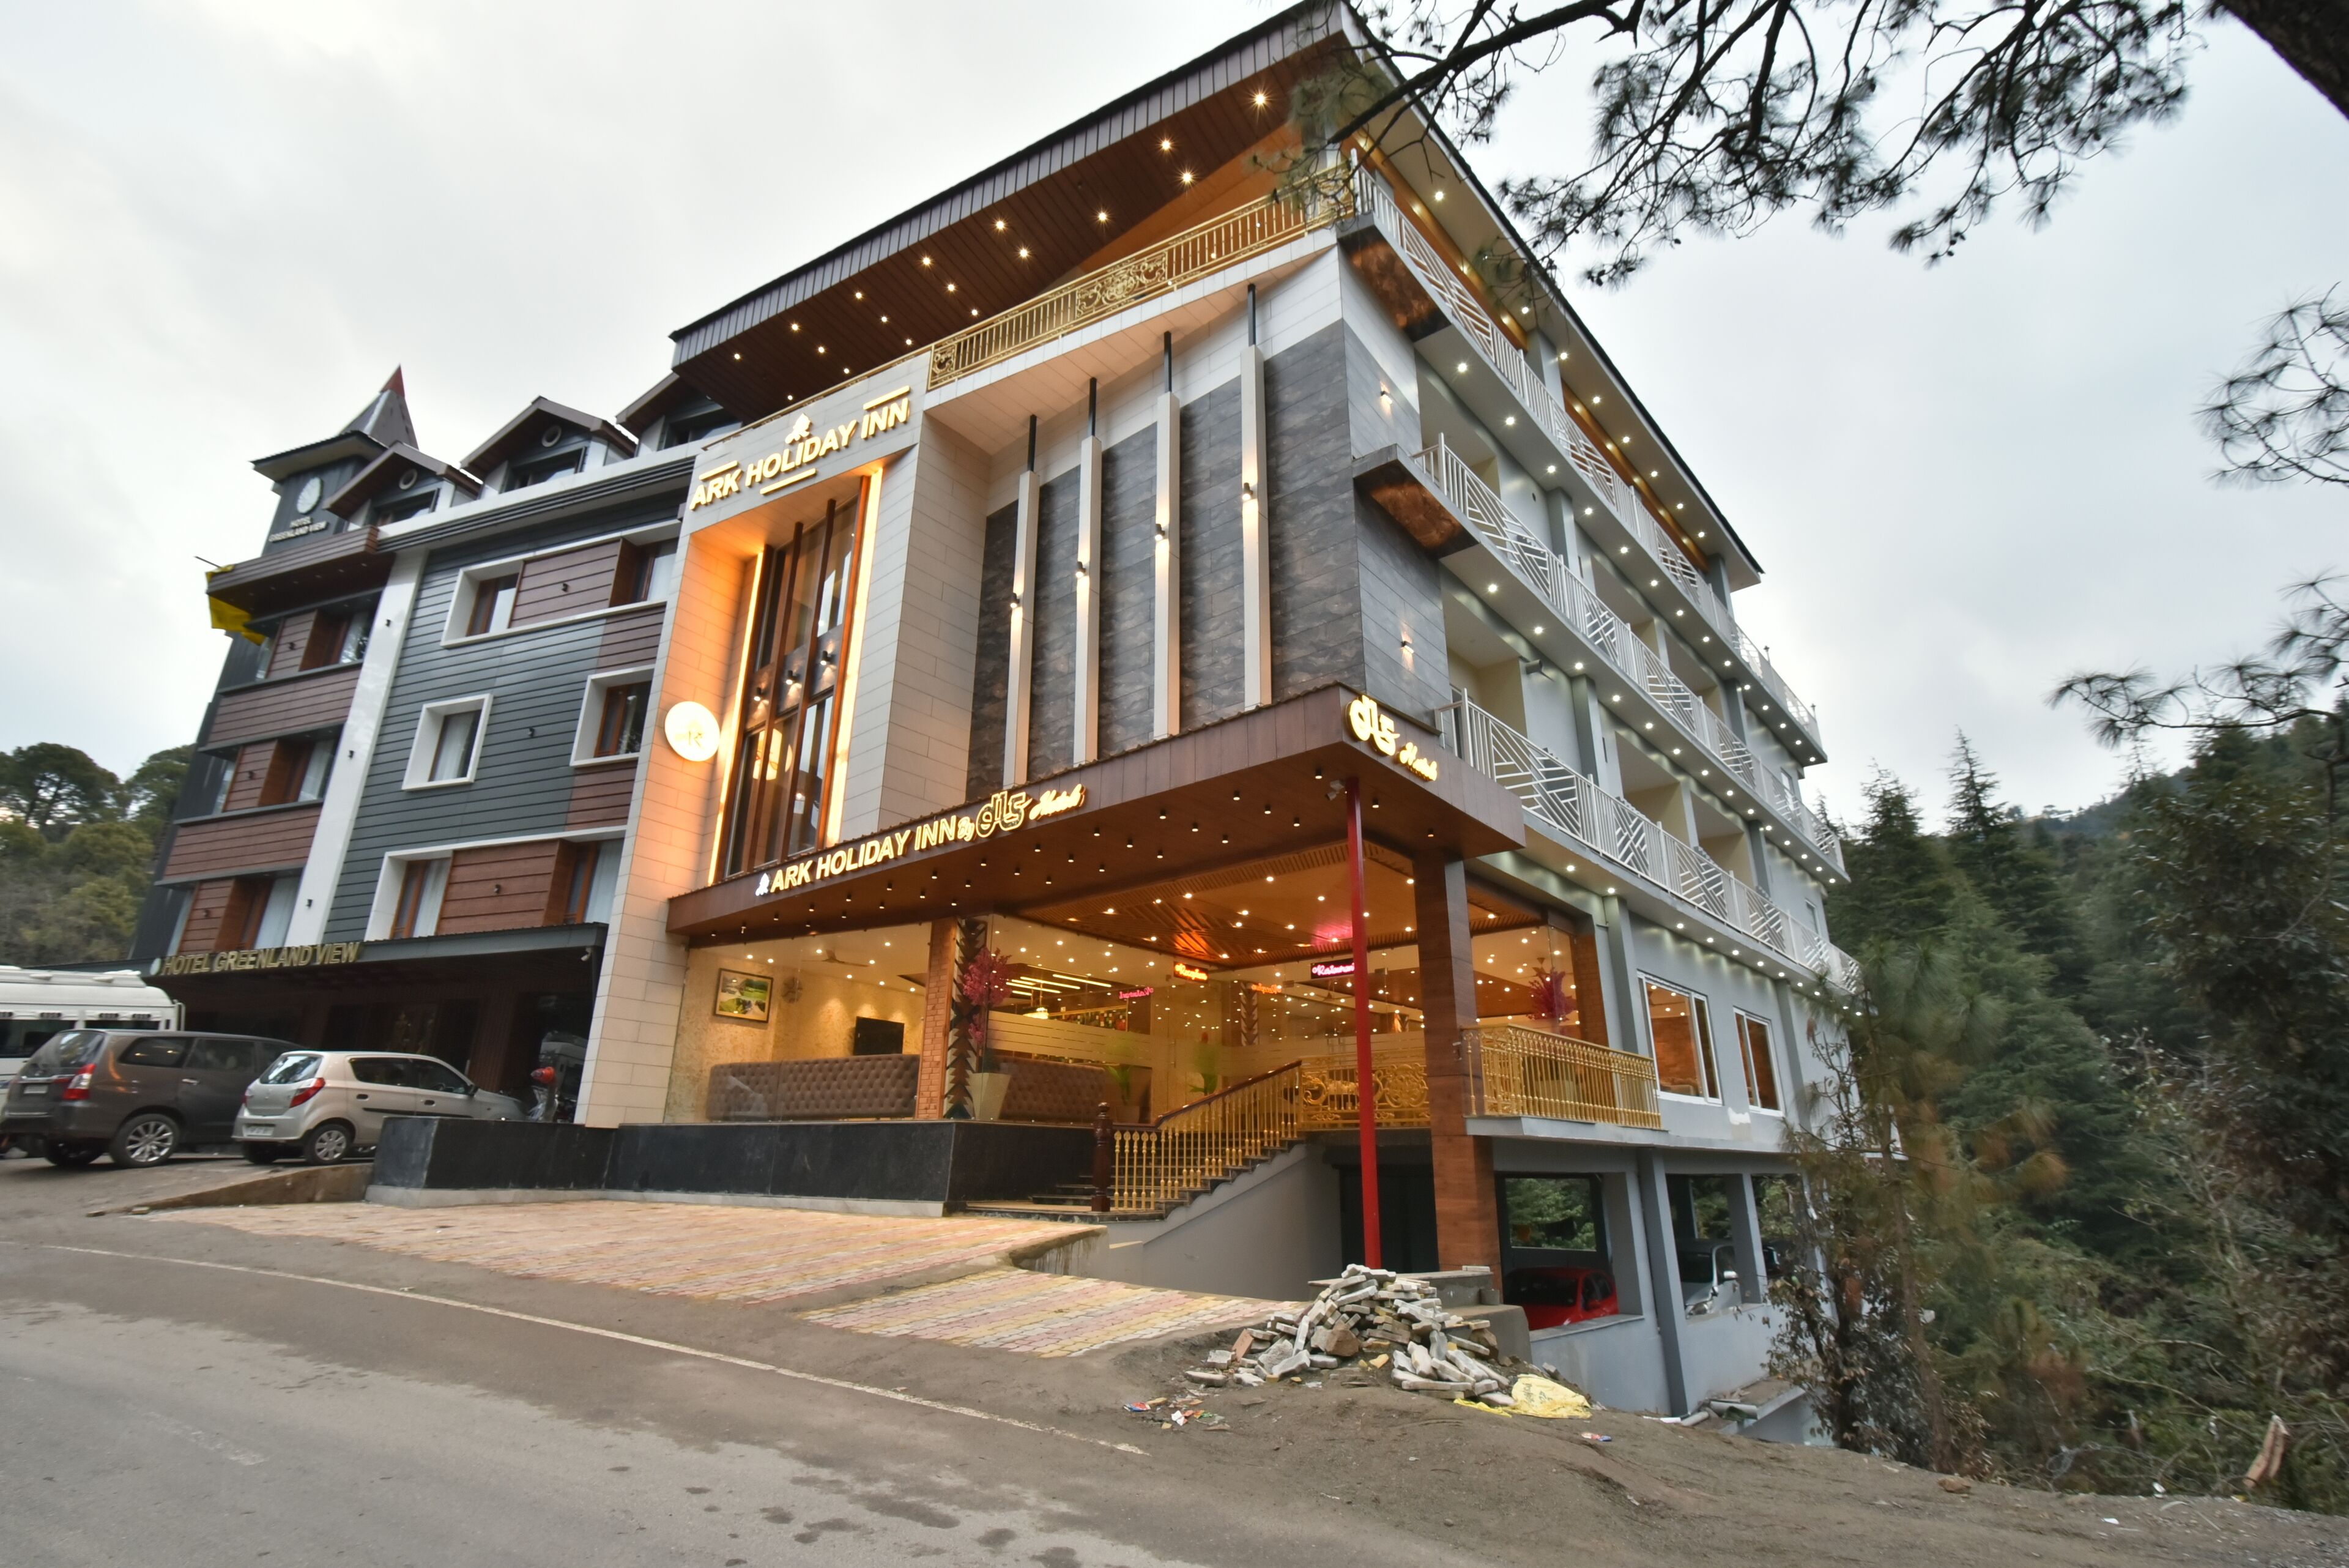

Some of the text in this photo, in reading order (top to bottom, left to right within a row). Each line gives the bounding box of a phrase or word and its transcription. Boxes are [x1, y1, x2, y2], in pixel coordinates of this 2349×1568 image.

[689, 398, 910, 511] ARK HOLIDAY INN
[770, 861, 814, 893] ARK
[816, 829, 910, 880] HOLIDAY
[915, 815, 957, 850] INN
[161, 942, 360, 975] HOTEL GREENLAND VIEW
